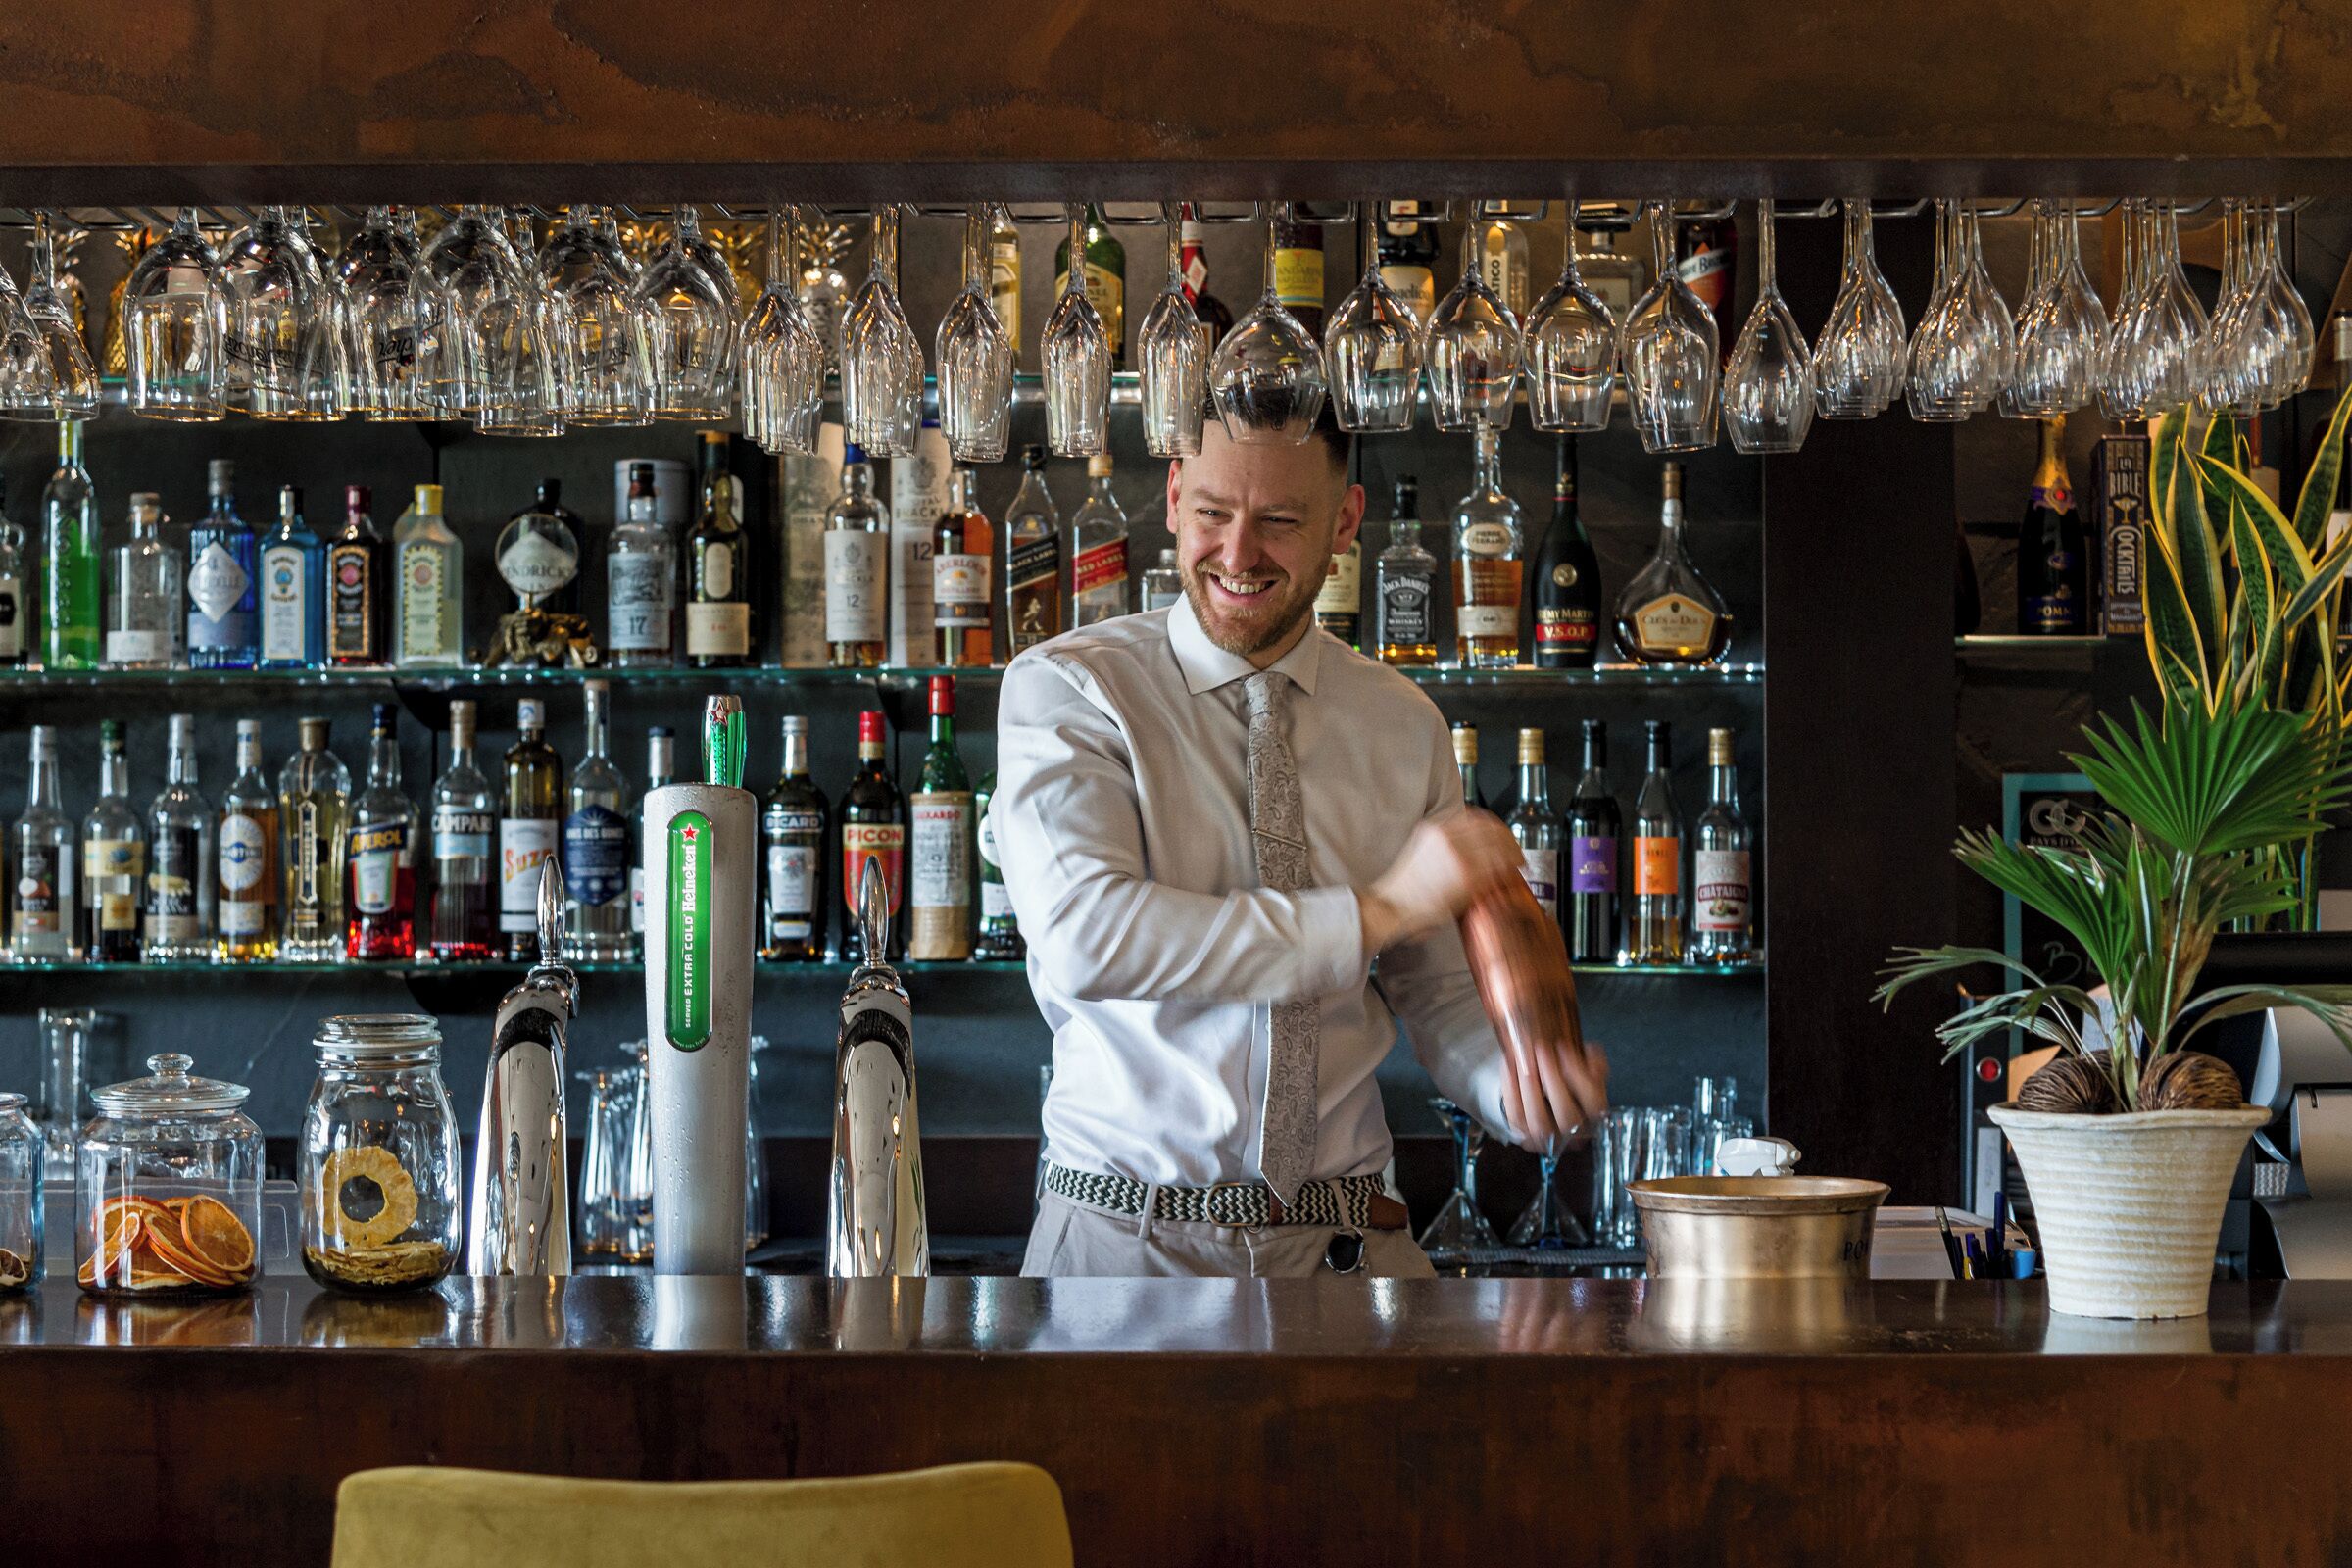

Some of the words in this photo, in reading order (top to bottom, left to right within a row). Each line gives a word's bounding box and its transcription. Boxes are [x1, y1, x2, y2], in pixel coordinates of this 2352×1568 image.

[2109, 471, 2142, 498] BIBLE
[912, 542, 934, 561] 12
[846, 594, 860, 608] 12
[629, 615, 648, 636] 17
[766, 815, 820, 828] RICARD
[351, 829, 402, 856] APEROL
[847, 828, 902, 843] PICON
[681, 844, 696, 912] Heineken
[683, 915, 693, 951] COLD
[683, 954, 693, 996] EXTRA
